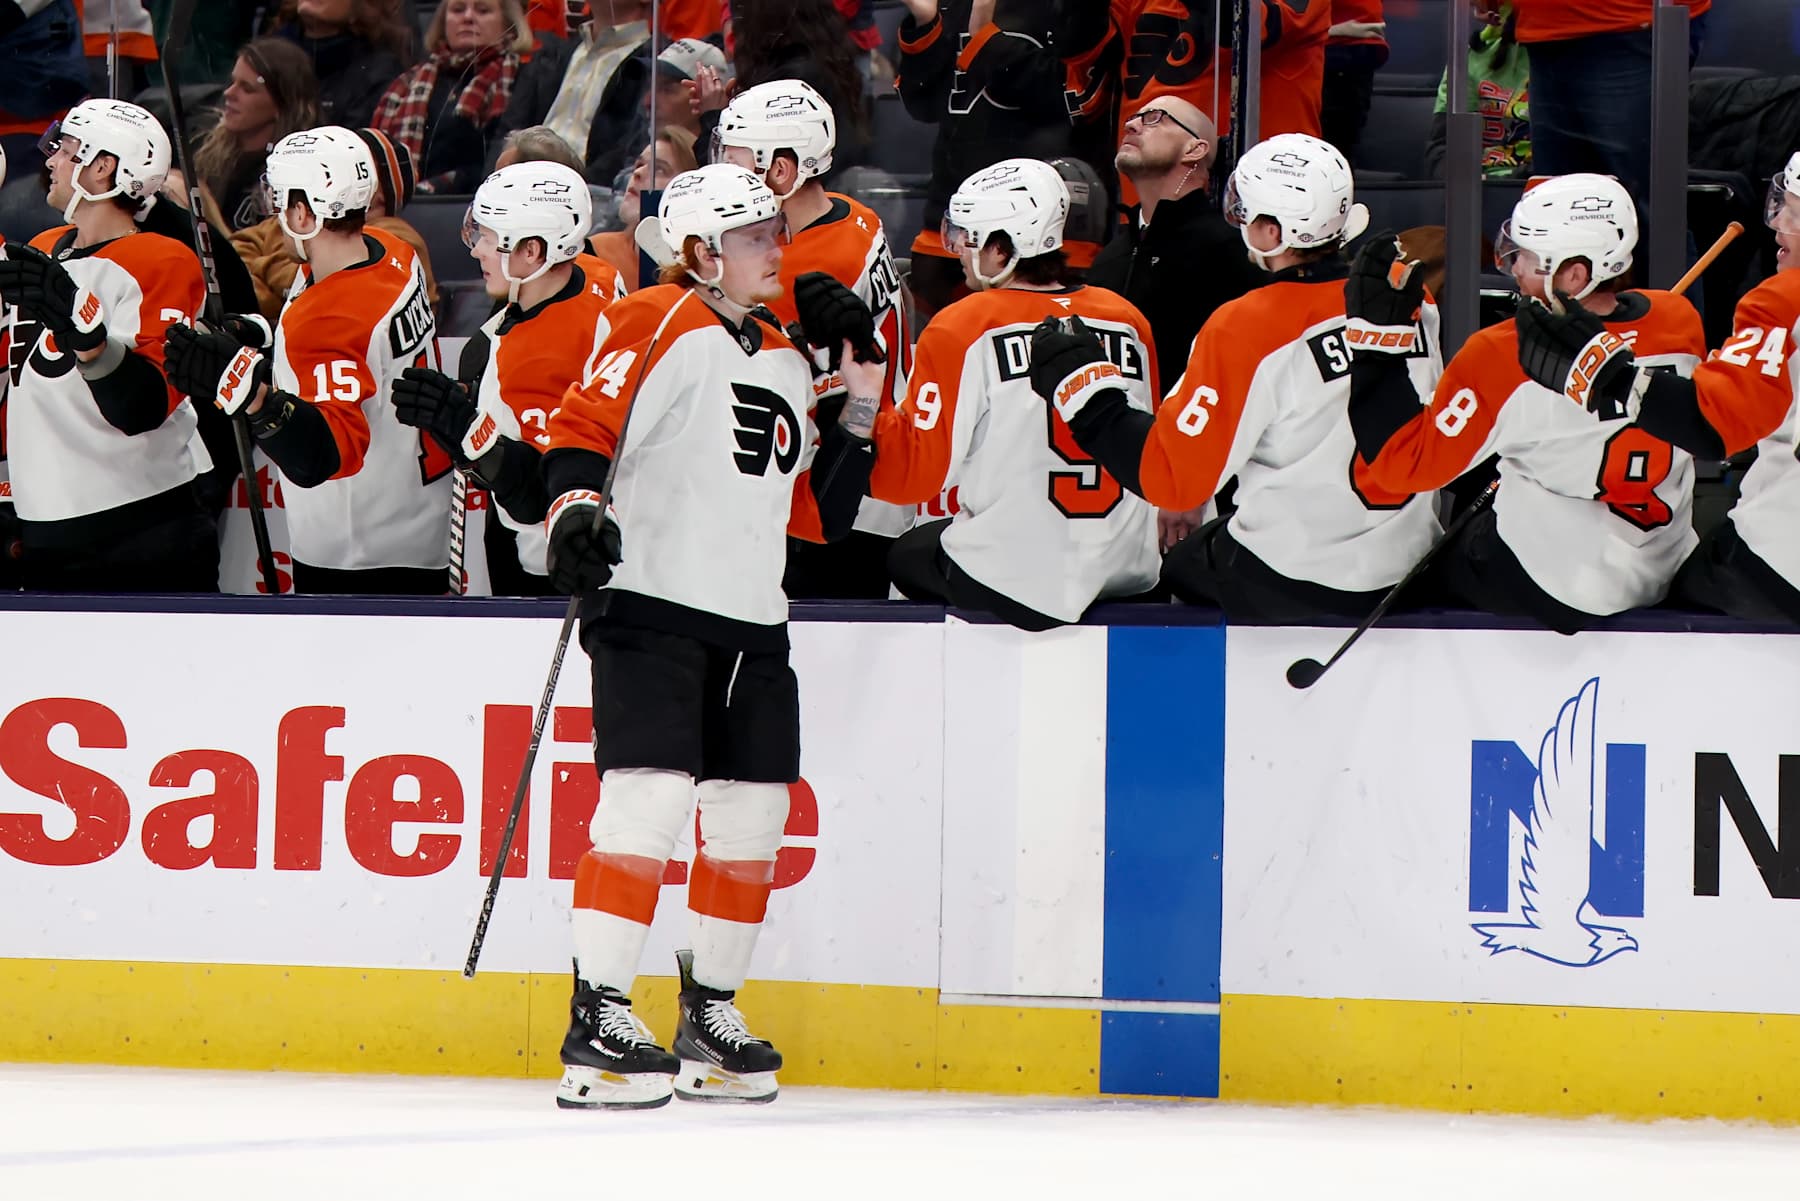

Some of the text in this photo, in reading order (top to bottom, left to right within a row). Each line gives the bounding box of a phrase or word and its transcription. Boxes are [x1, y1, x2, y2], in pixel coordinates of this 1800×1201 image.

[354, 161, 370, 181] 15
[752, 193, 772, 205] CCM
[1339, 197, 1348, 215] 6
[1569, 213, 1616, 222] CHEVROLET
[189, 186, 221, 294] CCM
[219, 345, 257, 402] CCM
[1566, 333, 1625, 406] CCM
[1719, 326, 1788, 379] 24
[312, 359, 361, 403] 15
[913, 381, 943, 431] 9
[1176, 384, 1220, 438] 6
[1434, 387, 1478, 438] 8
[1594, 422, 1674, 533] 8
[0, 697, 819, 891] Safeli
[694, 1038, 725, 1063] BAUER
